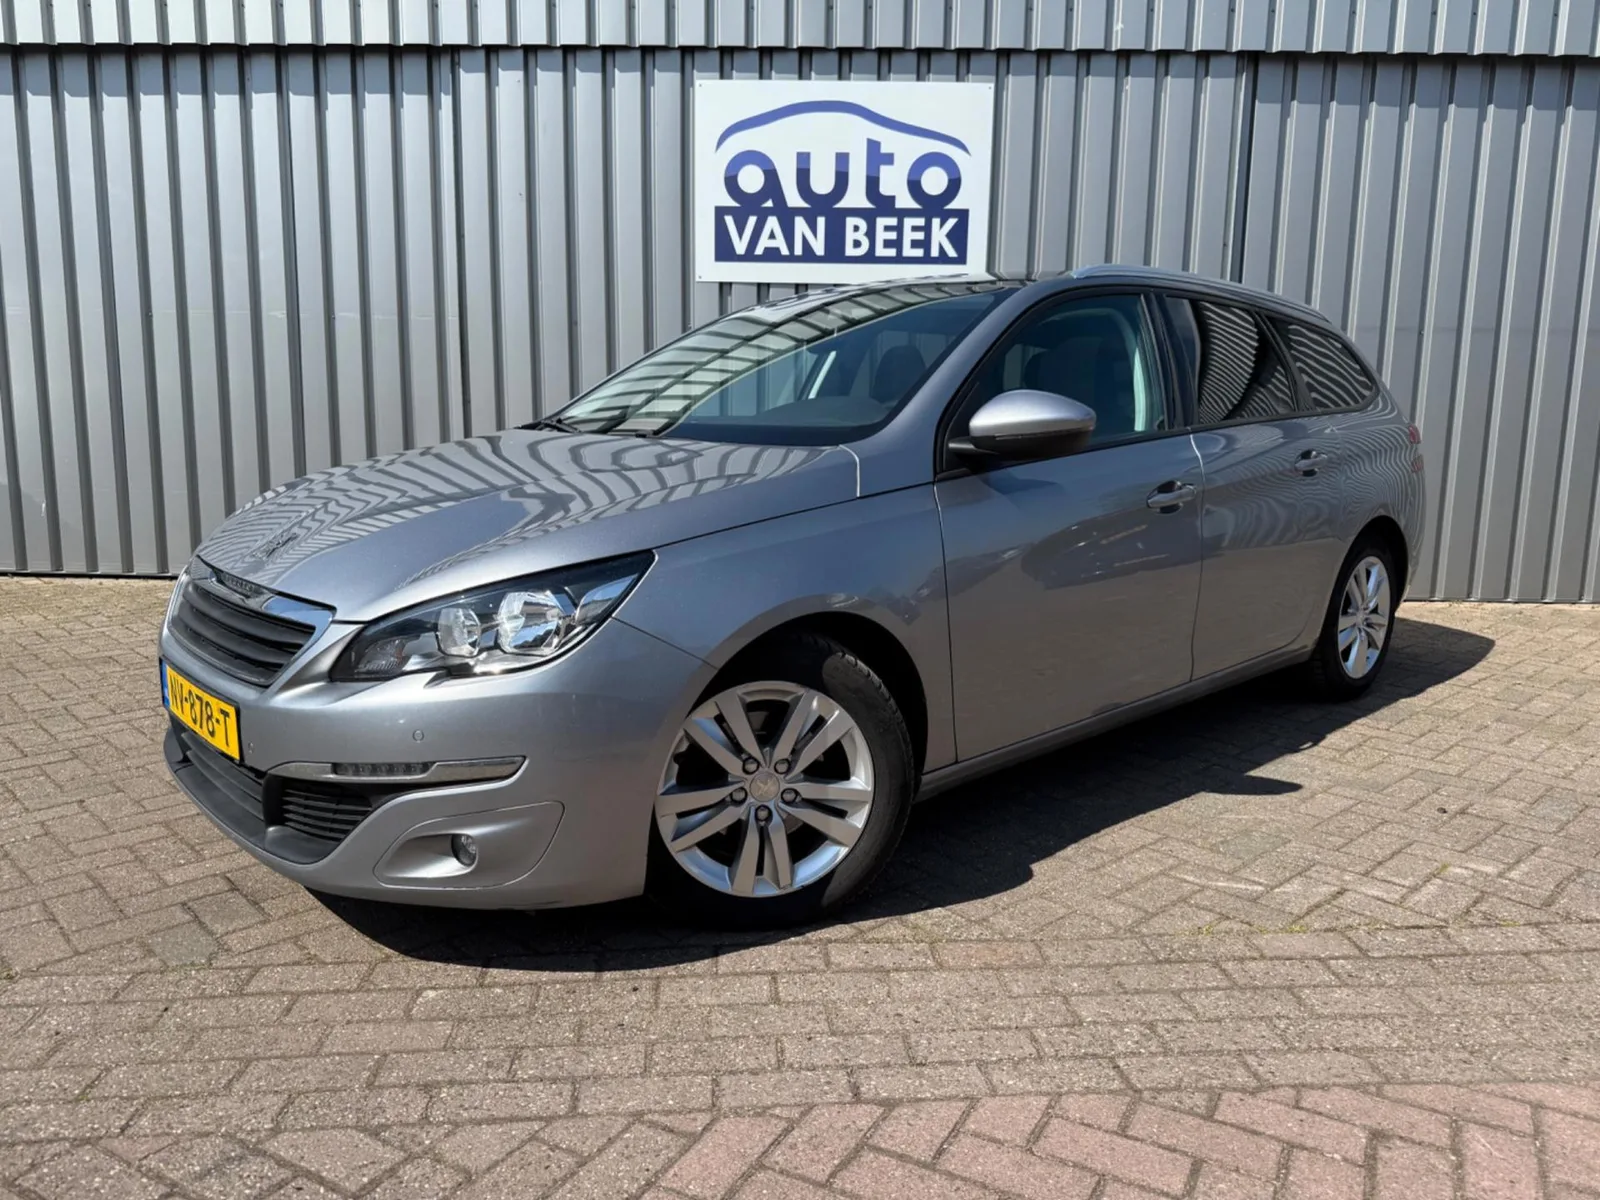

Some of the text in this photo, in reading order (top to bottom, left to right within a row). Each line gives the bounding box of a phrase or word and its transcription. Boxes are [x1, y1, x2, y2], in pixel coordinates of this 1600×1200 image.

[724, 137, 962, 209] auto
[723, 215, 959, 258] VAN BEEK
[169, 673, 231, 748] NV-878-T
